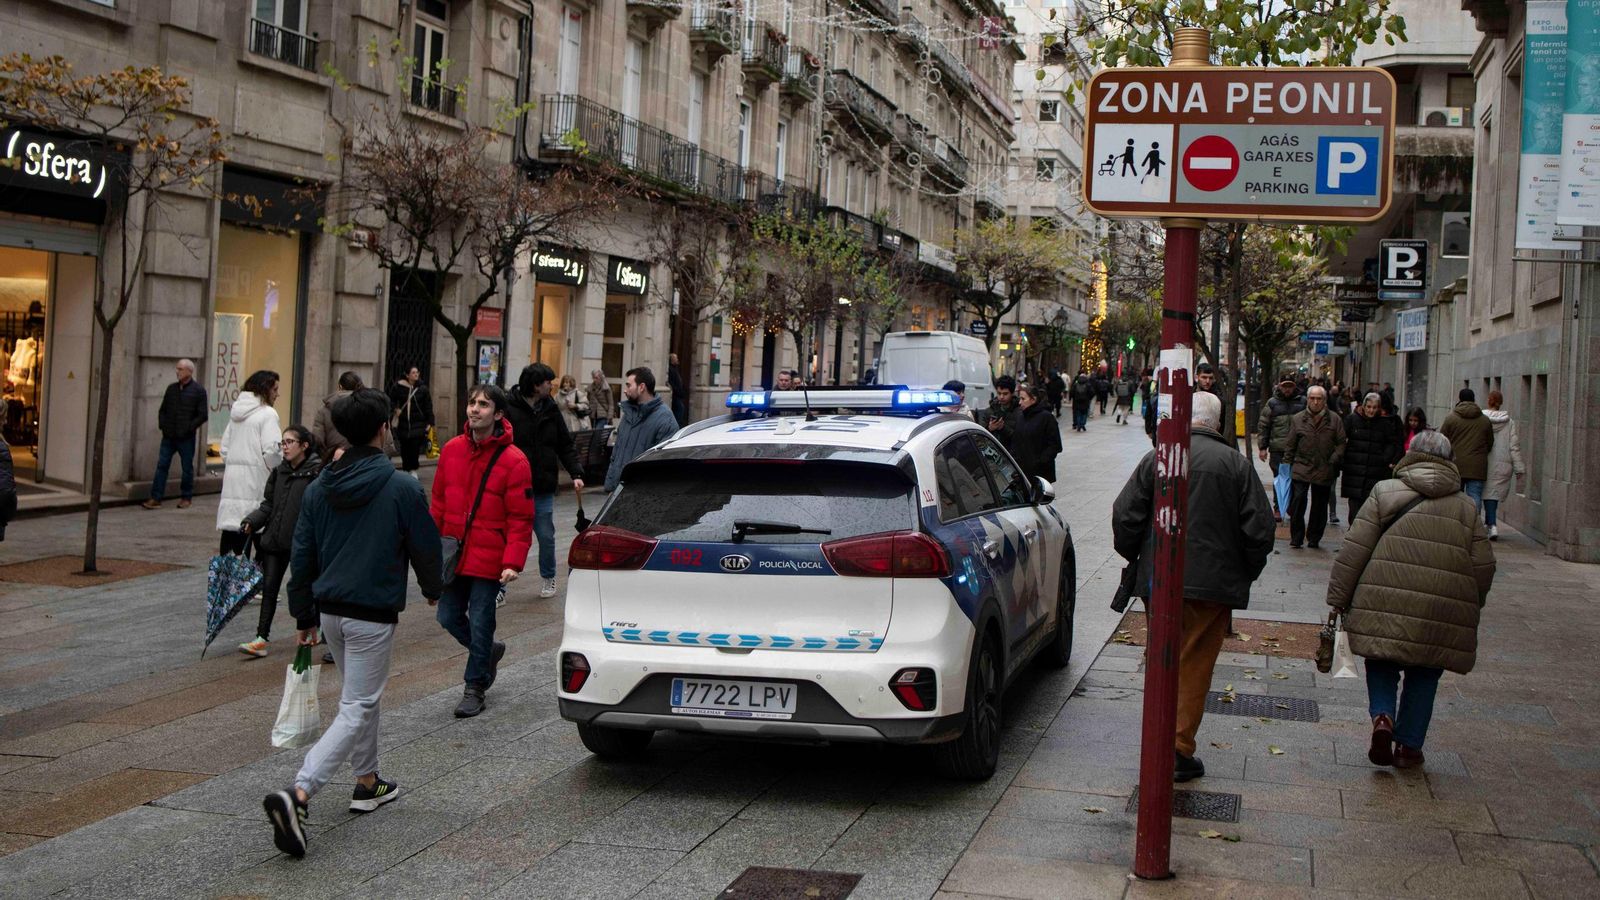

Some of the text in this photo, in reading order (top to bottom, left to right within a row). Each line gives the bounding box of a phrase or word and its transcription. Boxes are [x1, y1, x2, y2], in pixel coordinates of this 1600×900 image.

[1098, 82, 1382, 114] ZONA PEONIL
[1259, 132, 1300, 147] AGÁS
[1243, 150, 1314, 164] GARAXES
[1326, 141, 1367, 189] P
[1273, 166, 1282, 178] E
[1244, 181, 1309, 195] PARKING
[1387, 247, 1419, 279] P
[217, 342, 239, 365] RE
[216, 366, 238, 389] BA
[723, 558, 746, 568] KIA
[759, 559, 822, 569] POLICÍA LOCAL
[686, 682, 791, 709] 7722 LPV
